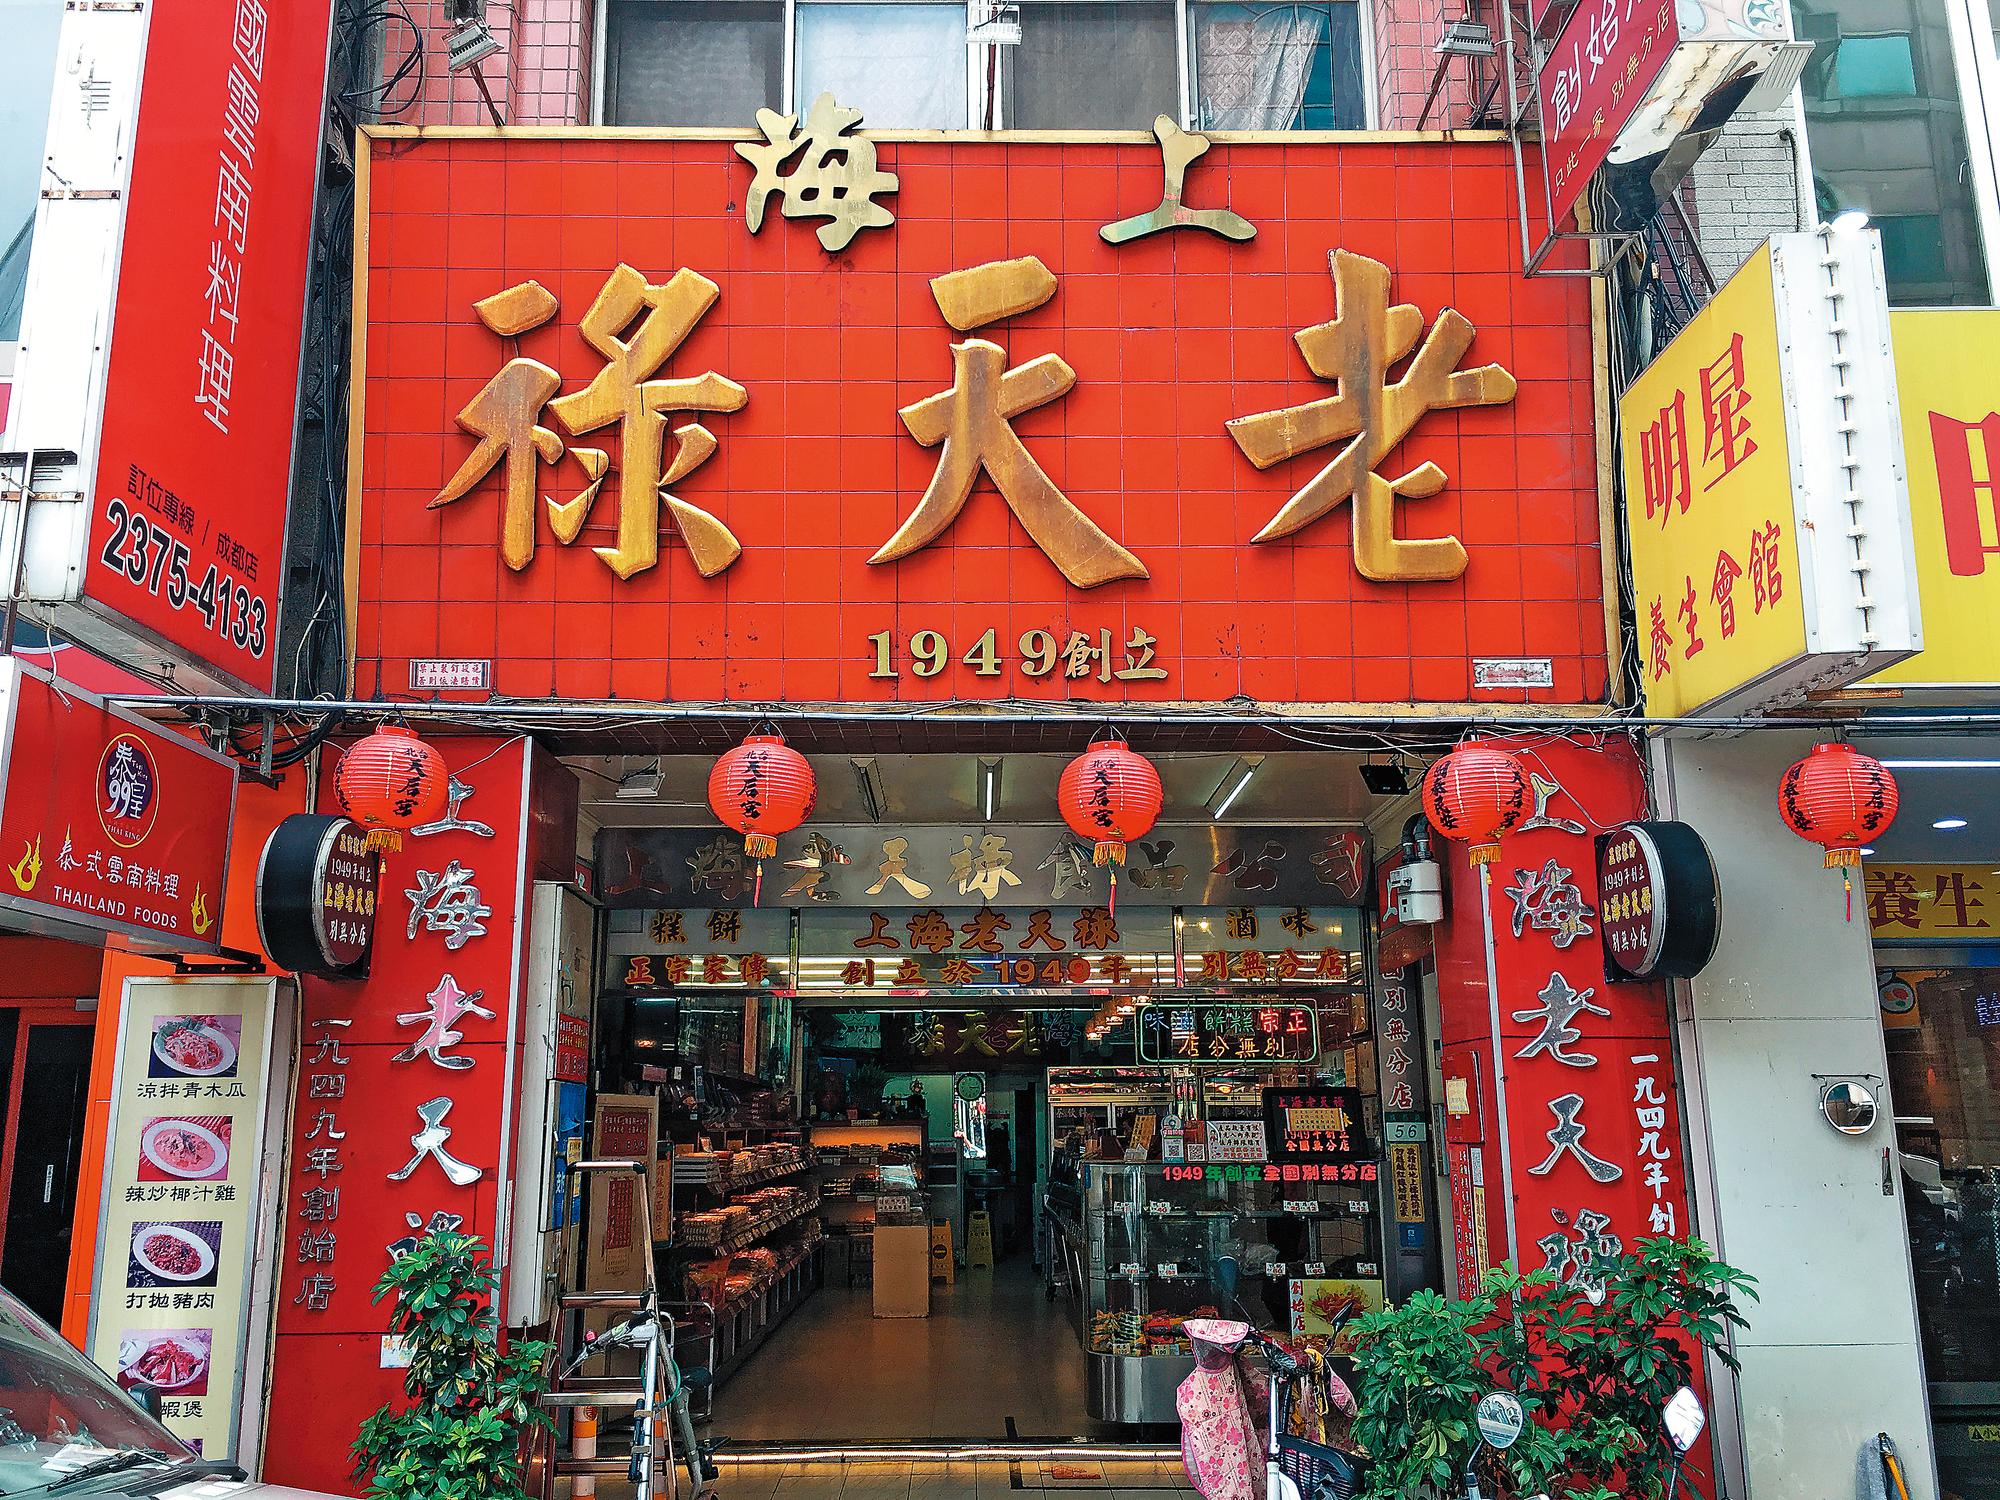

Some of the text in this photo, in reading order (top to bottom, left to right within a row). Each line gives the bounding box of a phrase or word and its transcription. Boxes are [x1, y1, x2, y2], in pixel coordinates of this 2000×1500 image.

[1554, 2, 1670, 197] 只此一家 別無分店
[427, 247, 1517, 590] 老天祿
[1640, 332, 1759, 531] 明星
[100, 496, 268, 660] 2375-4133
[1648, 519, 1782, 683] 養生會館
[867, 627, 1168, 683] 1949創立
[737, 761, 763, 819] 天后宮
[1089, 769, 1115, 828] 天后宮
[55, 839, 180, 900] 泰式雲南料理
[53, 884, 178, 929] THAILAND FOODS
[1224, 906, 1318, 940] 滷味
[1862, 870, 2000, 931] 養生
[650, 909, 743, 944] 糕餅
[853, 907, 1120, 954] 上海老天祿
[624, 952, 770, 987] 正宗家傳
[840, 954, 1132, 988] 創立於1949年
[1200, 947, 1349, 980] 別無分店
[1178, 1030, 1286, 1059] 別無分店
[1381, 965, 1413, 1110] 別無分店
[137, 1081, 247, 1099] 涼拌青木瓜
[1394, 1124, 1418, 1139] 56
[294, 1017, 353, 1311] 一九四九年創始店
[1162, 1164, 1378, 1182] 1949年創立全國別無分店
[1629, 1052, 1682, 1290] 一九四九年創
[125, 1184, 237, 1203] 辣炒椰汁雞
[1290, 1280, 1306, 1331] 創始店
[161, 1400, 203, 1418] 蝦煲
